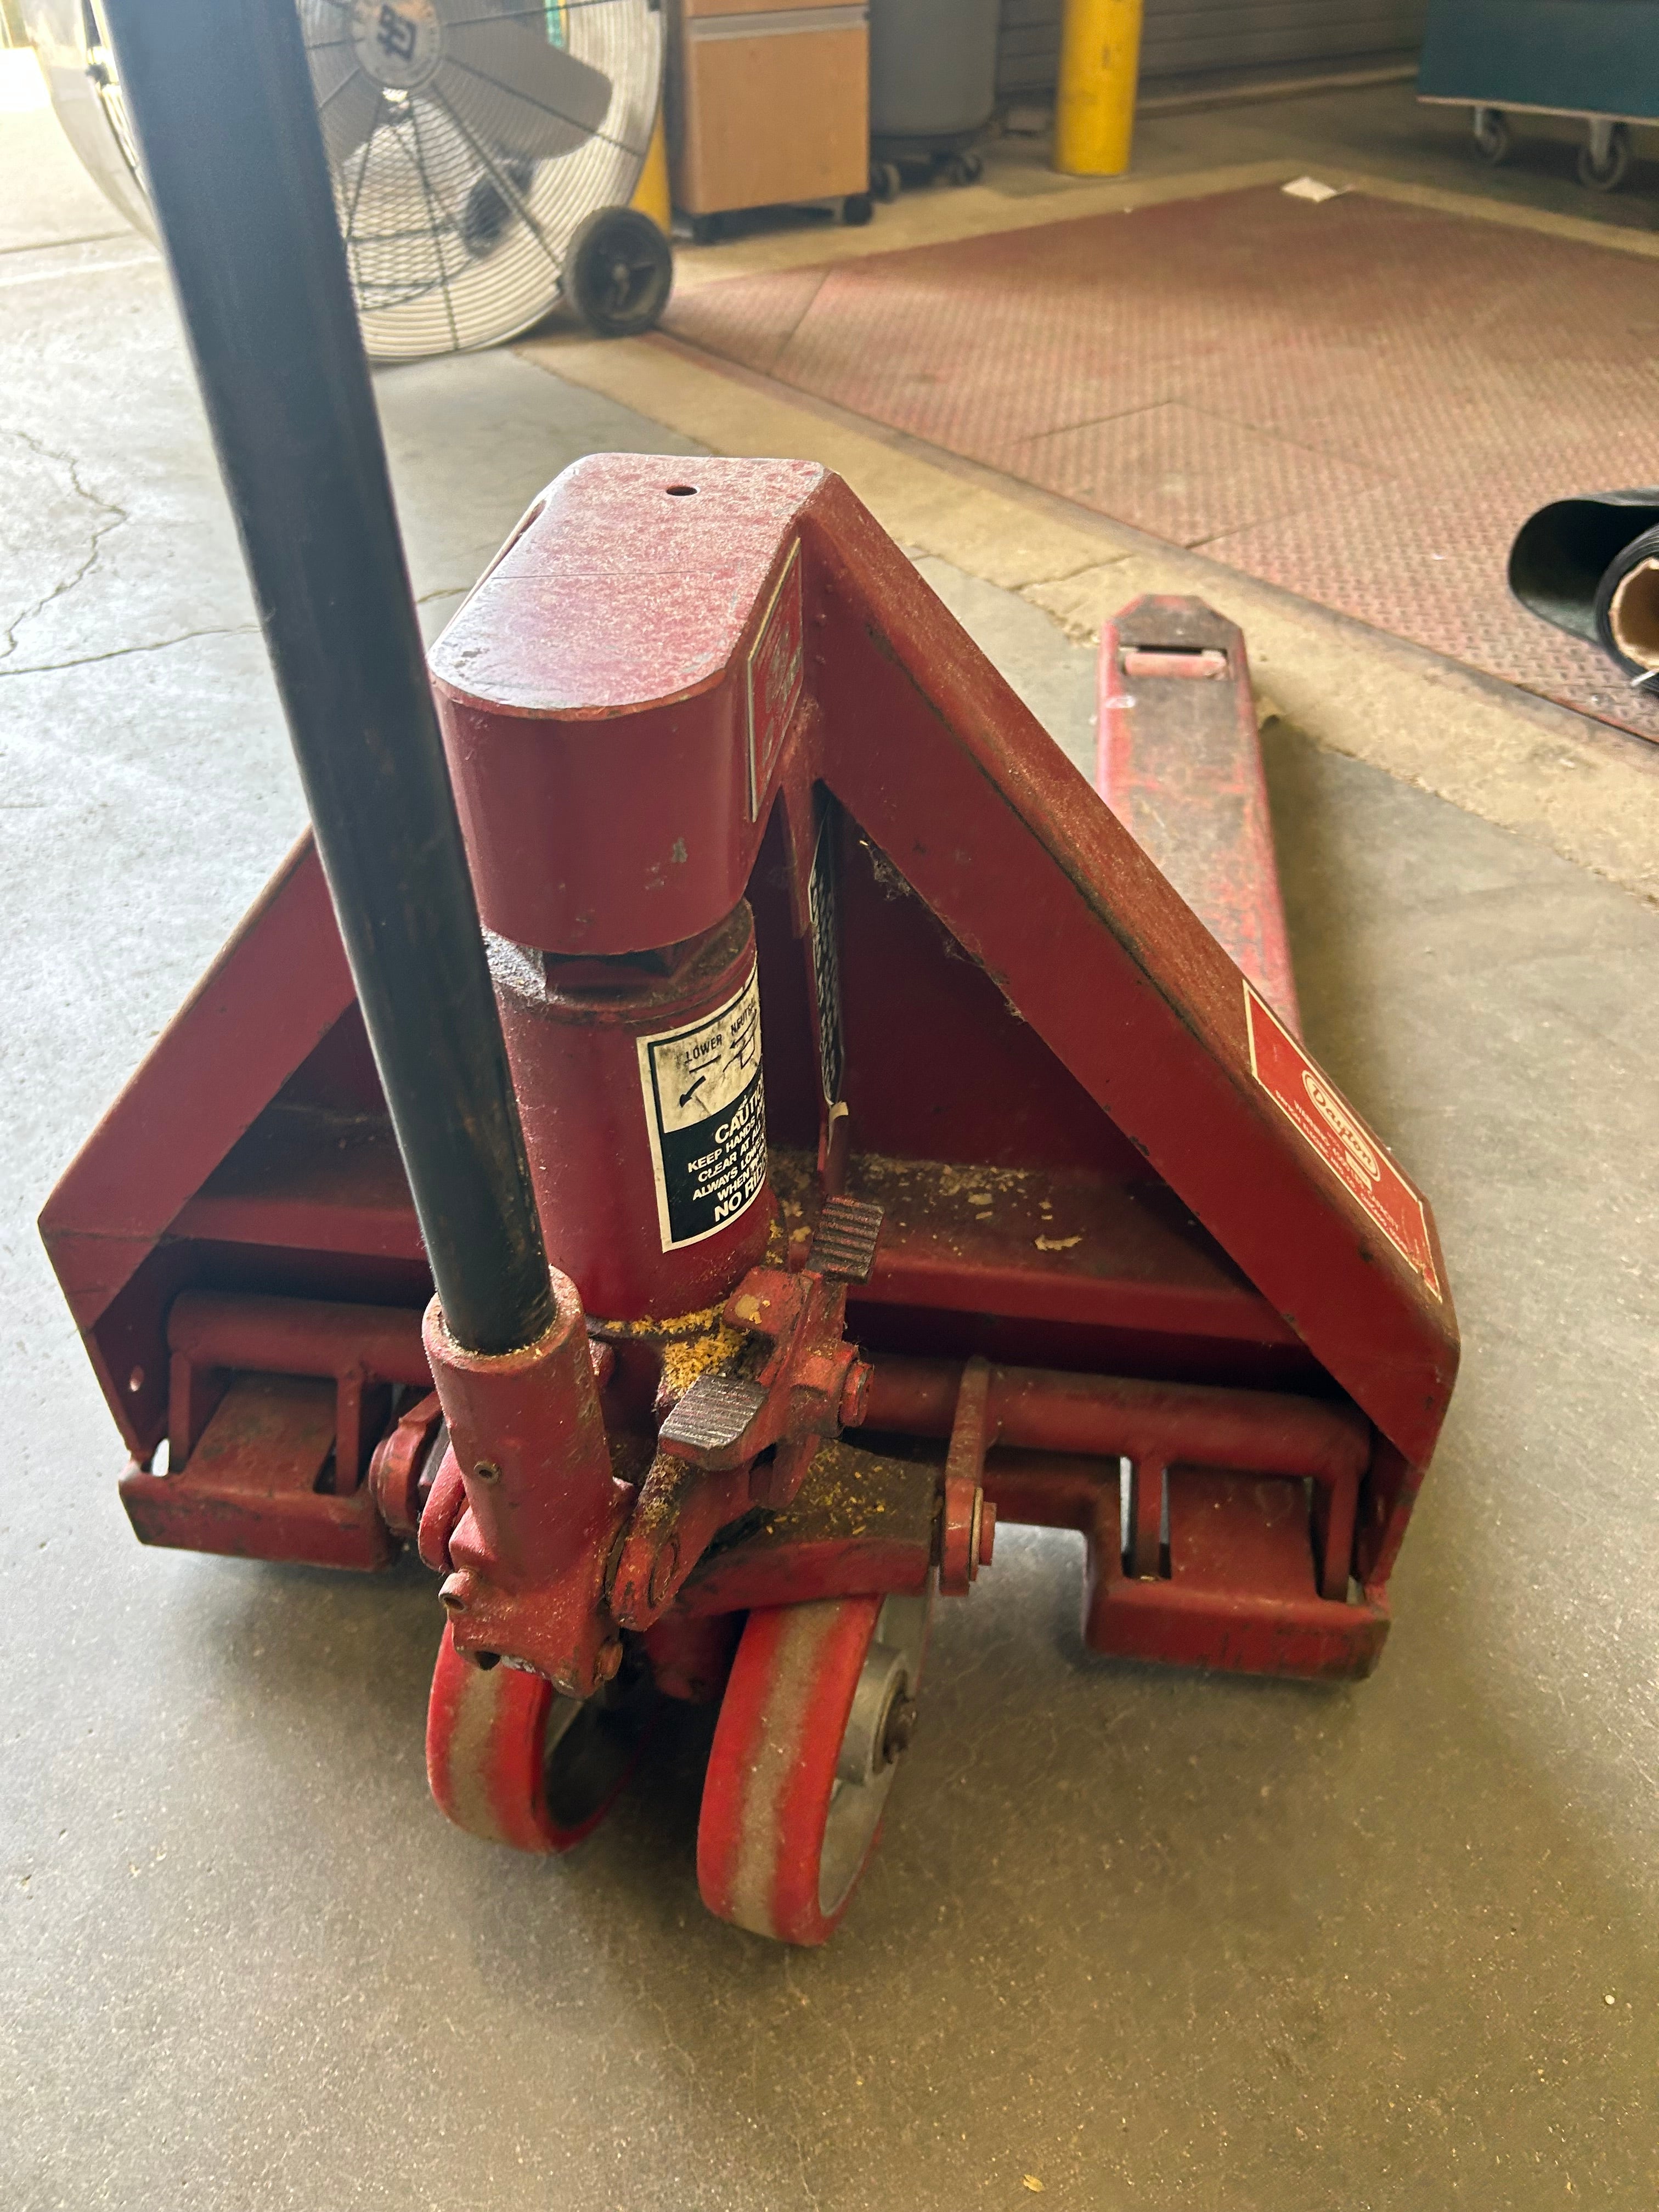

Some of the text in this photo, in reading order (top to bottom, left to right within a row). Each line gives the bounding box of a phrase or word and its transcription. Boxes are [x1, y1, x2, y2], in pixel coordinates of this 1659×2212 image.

[685, 995, 756, 1064] LOWER NEUTR
[688, 1148, 723, 1173] KEEP
[726, 1116, 755, 1152] HANDS
[1312, 1083, 1372, 1164] Dayton
[698, 1152, 737, 1182] CLEAR
[740, 1137, 750, 1155] AT
[693, 1166, 738, 1200] ALWAYS
[717, 1167, 750, 1201] WHEN
[714, 1191, 742, 1222] NO
